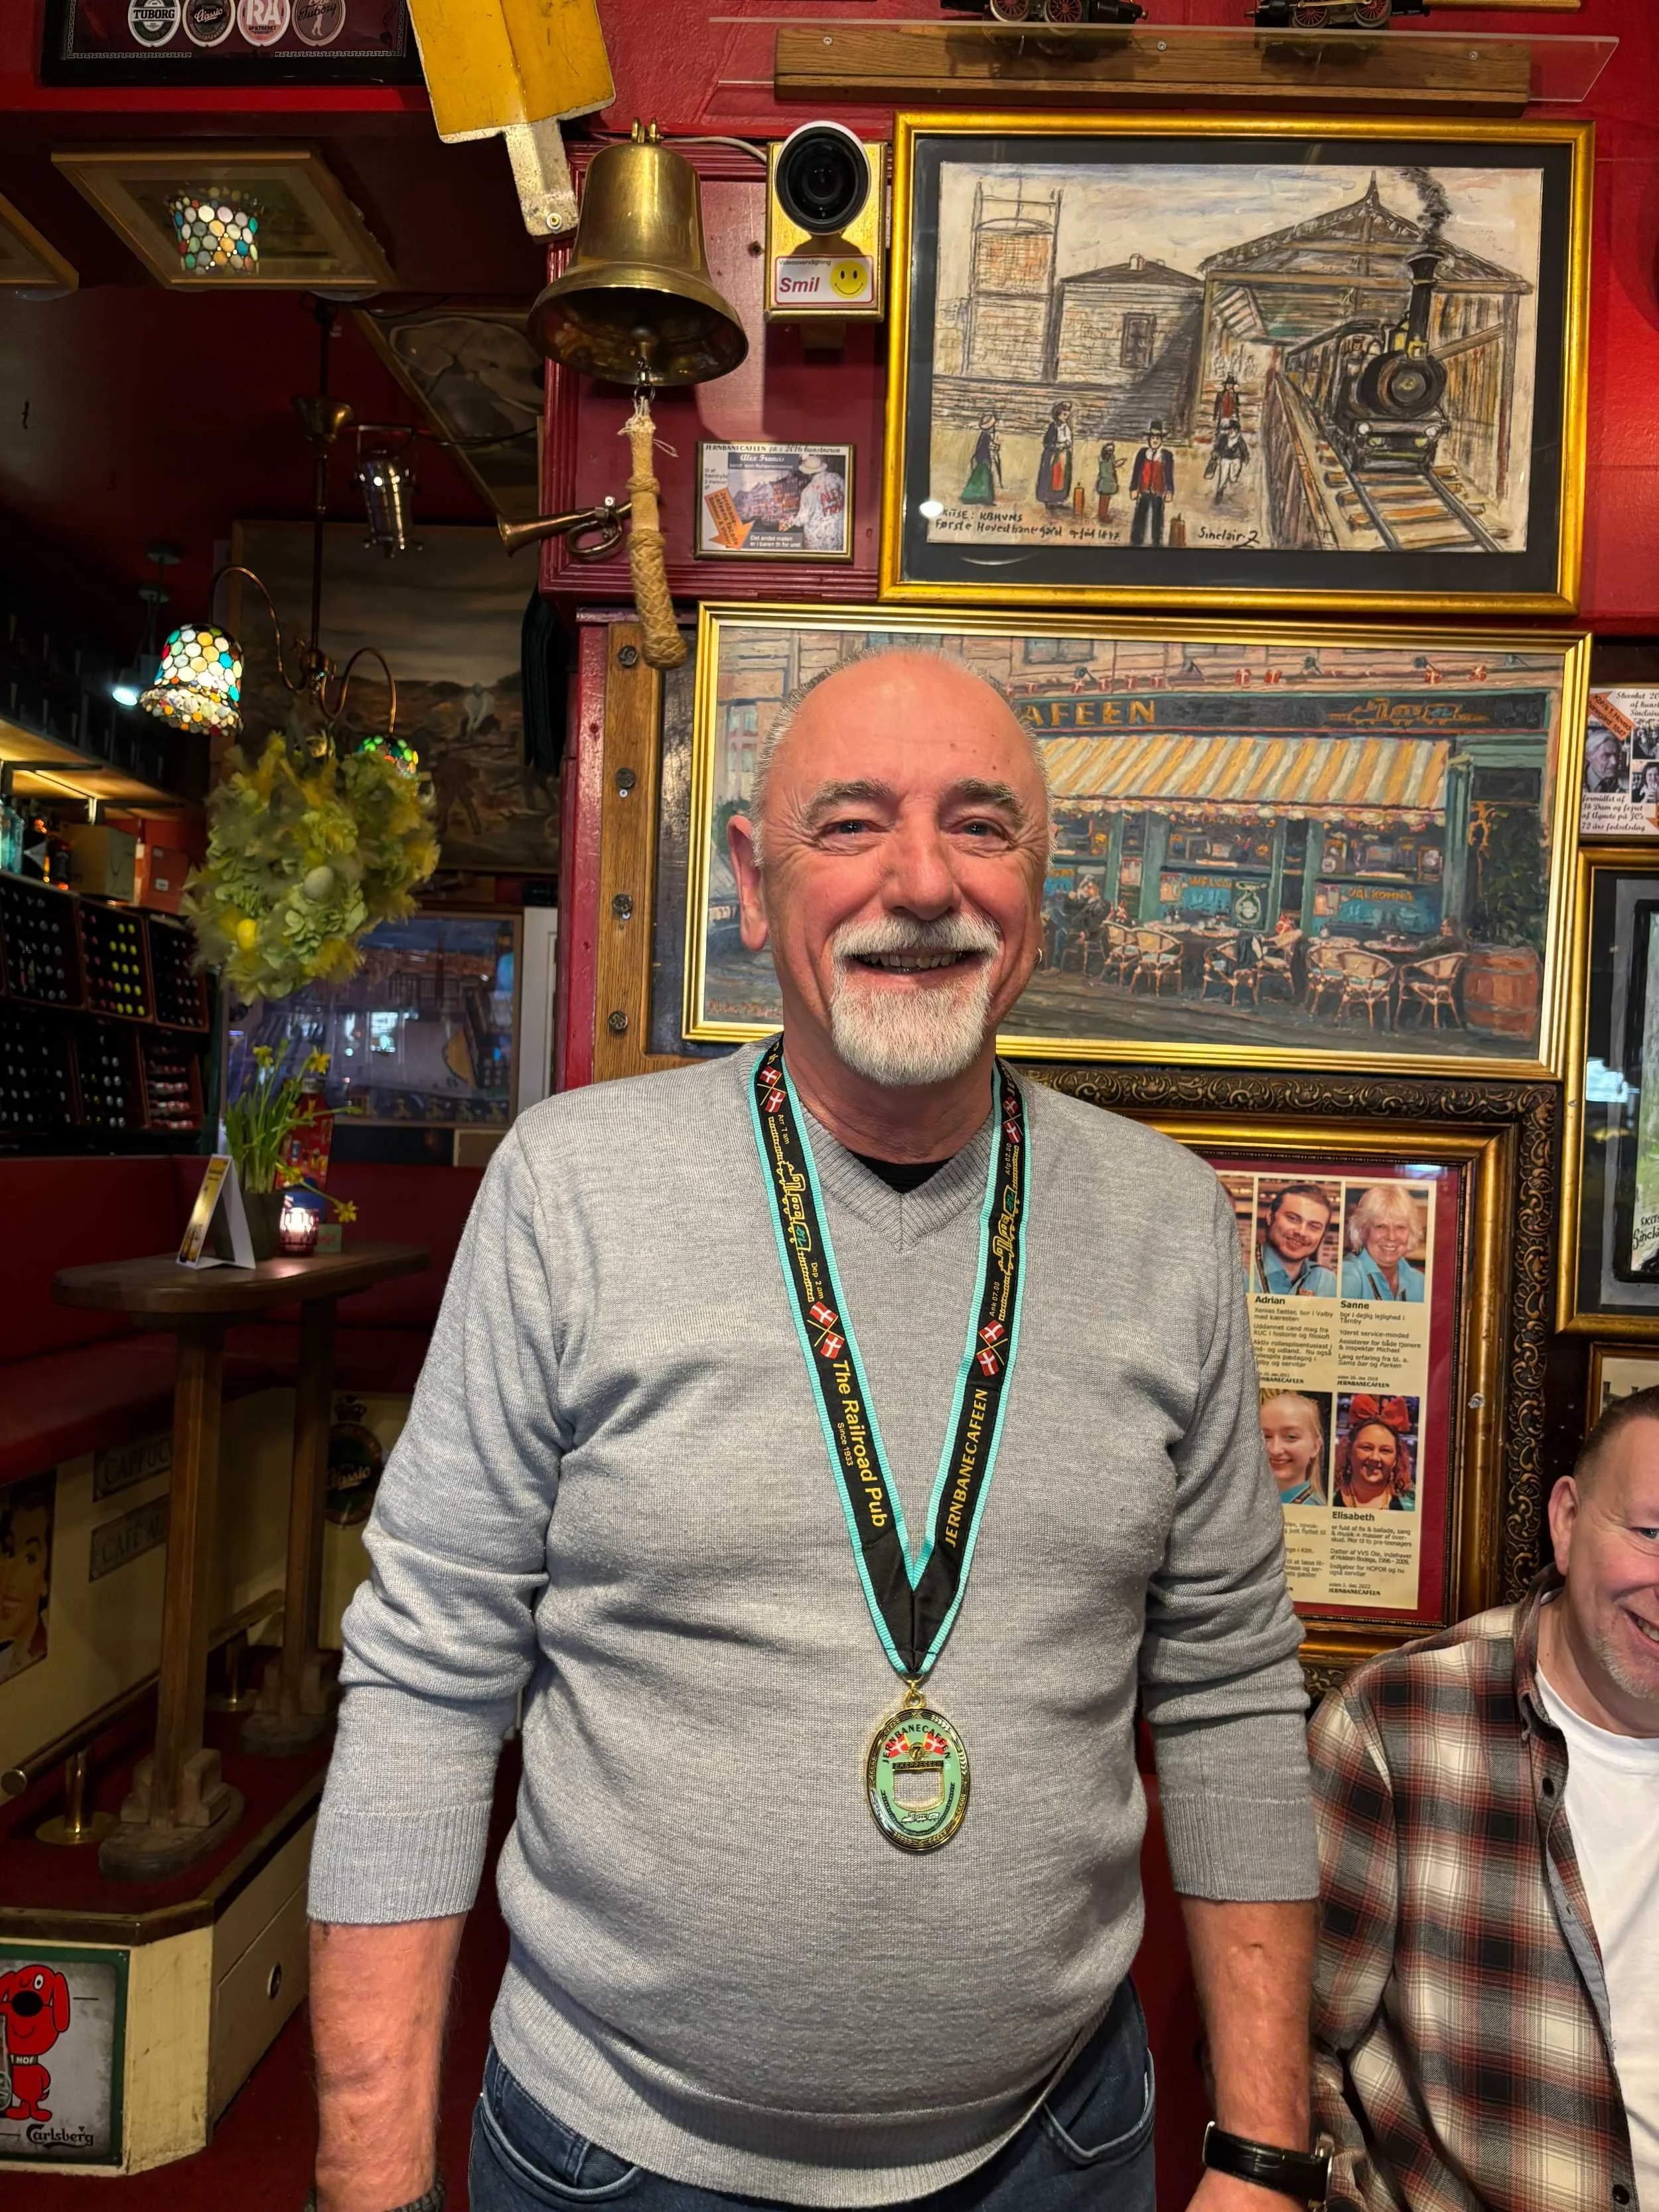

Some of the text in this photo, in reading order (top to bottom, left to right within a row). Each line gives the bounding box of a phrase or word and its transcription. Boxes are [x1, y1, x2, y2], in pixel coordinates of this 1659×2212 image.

[133, 9, 175, 19] TUBORG
[194, 7, 224, 23] Classic
[779, 276, 820, 293] Smil
[942, 508, 974, 519] KITSE:
[1197, 526, 1246, 542] Sinclair
[1255, 1295, 1285, 1305] Adrian
[1340, 1301, 1370, 1309] Sanne
[833, 1360, 885, 1527] The Railroad Pub
[837, 1422, 853, 1467] Since 1933
[944, 1388, 988, 1548] JERNBANECAFEEN
[1332, 1511, 1375, 1521] Elisabeth
[882, 1724, 951, 1764] JERNBANECAFEEN
[913, 1745, 921, 1758] 7
[27, 2124, 94, 2148] Carlsberg
